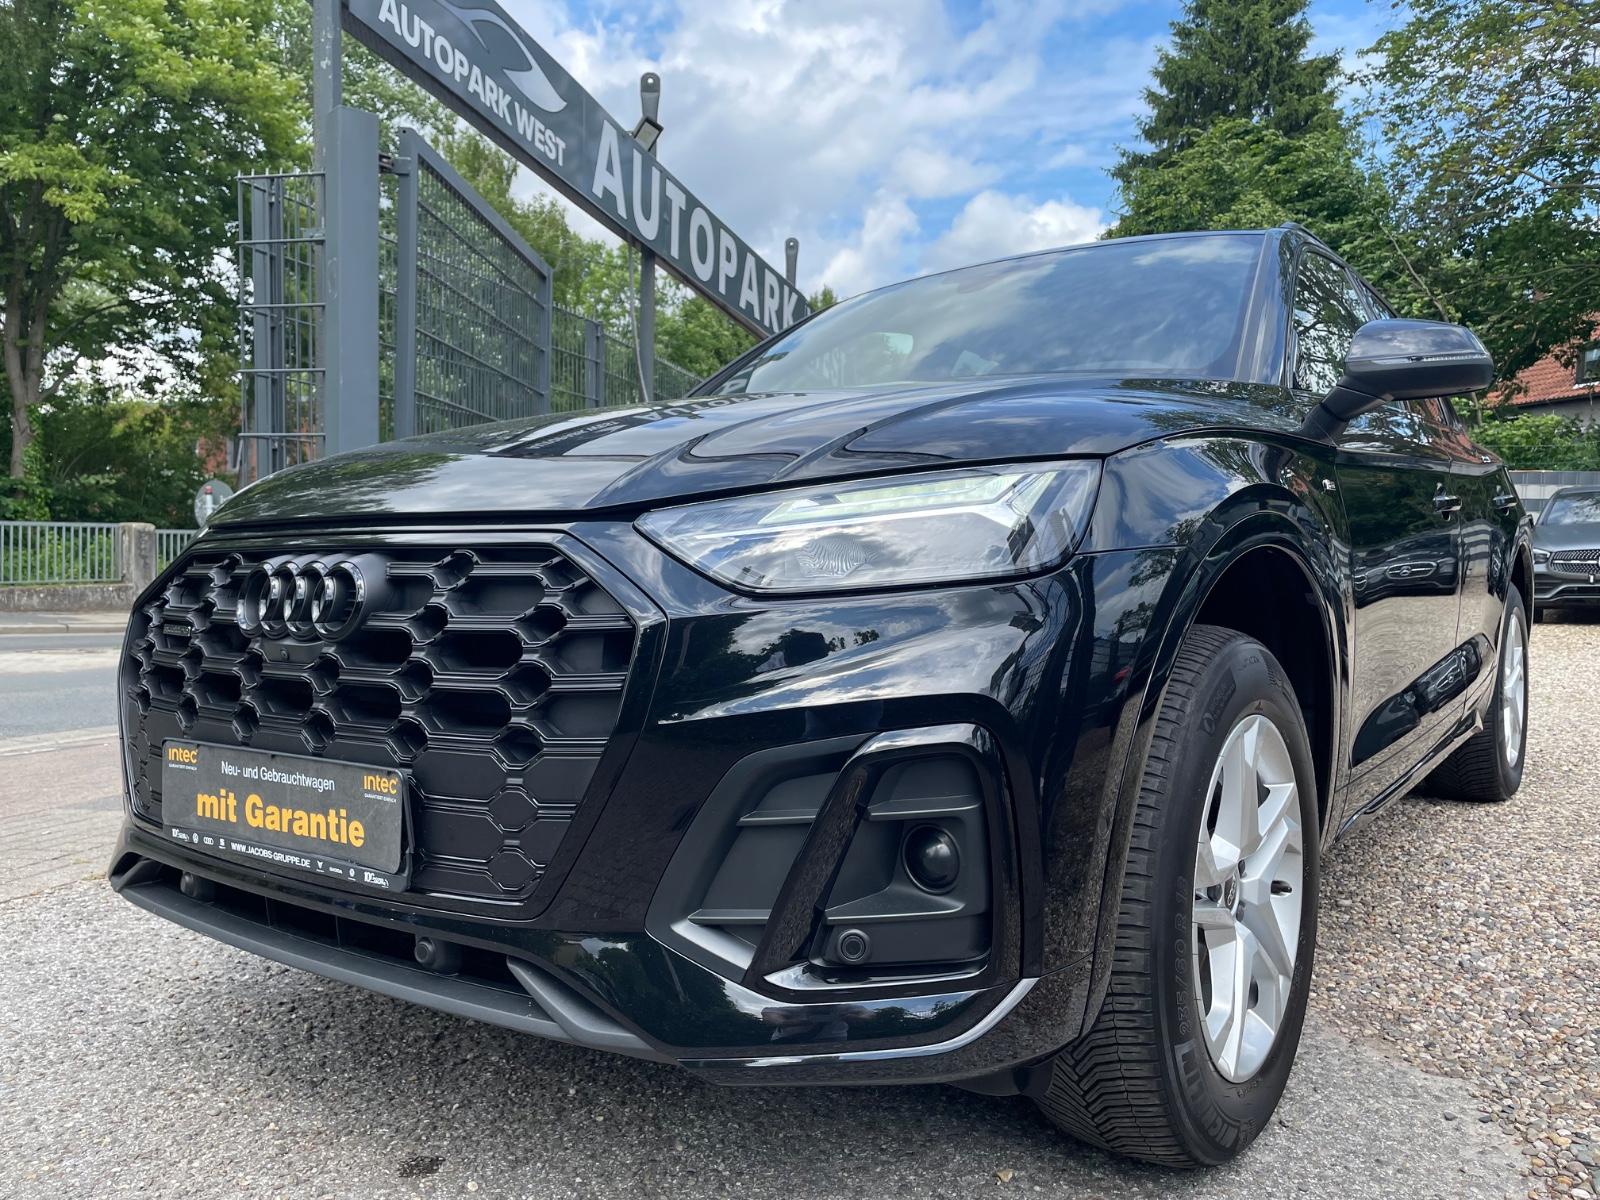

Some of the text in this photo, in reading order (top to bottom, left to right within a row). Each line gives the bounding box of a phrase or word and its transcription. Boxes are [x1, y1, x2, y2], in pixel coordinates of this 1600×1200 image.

[378, 0, 566, 167] AUTOPARK WEST
[592, 119, 799, 333] AUTOPARK
[168, 747, 198, 764] intec
[221, 761, 335, 792] Neu- und Gebrauchtwagen
[363, 775, 398, 795] intec
[197, 788, 365, 848] mit Garantie
[231, 842, 311, 869] WWW.JACOBS-GRUPPE.DE
